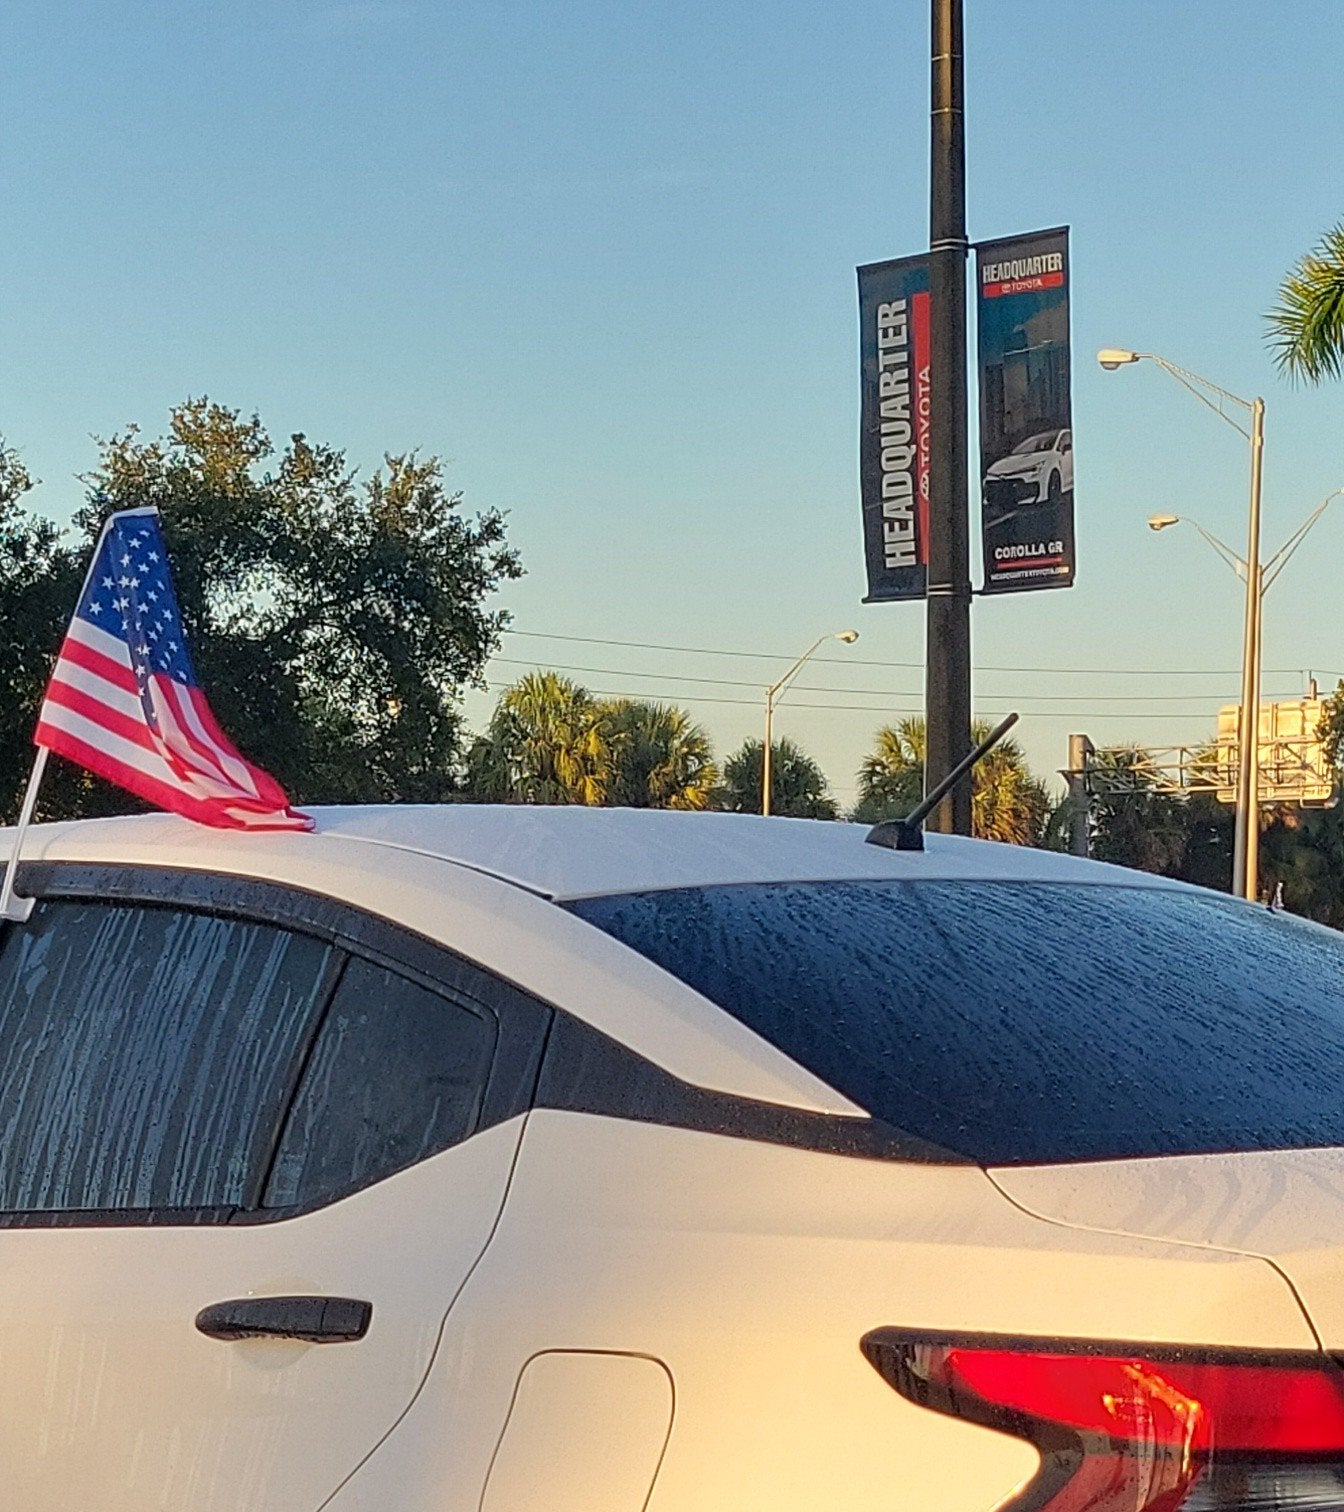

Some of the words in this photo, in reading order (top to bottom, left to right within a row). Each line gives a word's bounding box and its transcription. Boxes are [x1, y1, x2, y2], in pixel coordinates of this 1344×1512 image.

[983, 252, 1063, 284] HEADQUARTER
[1012, 278, 1043, 291] TOYOTA
[918, 365, 931, 468] TOYOTA
[877, 298, 917, 569] HEADQUARTER
[995, 543, 1046, 560] COROLLA
[1048, 541, 1063, 553] GR
